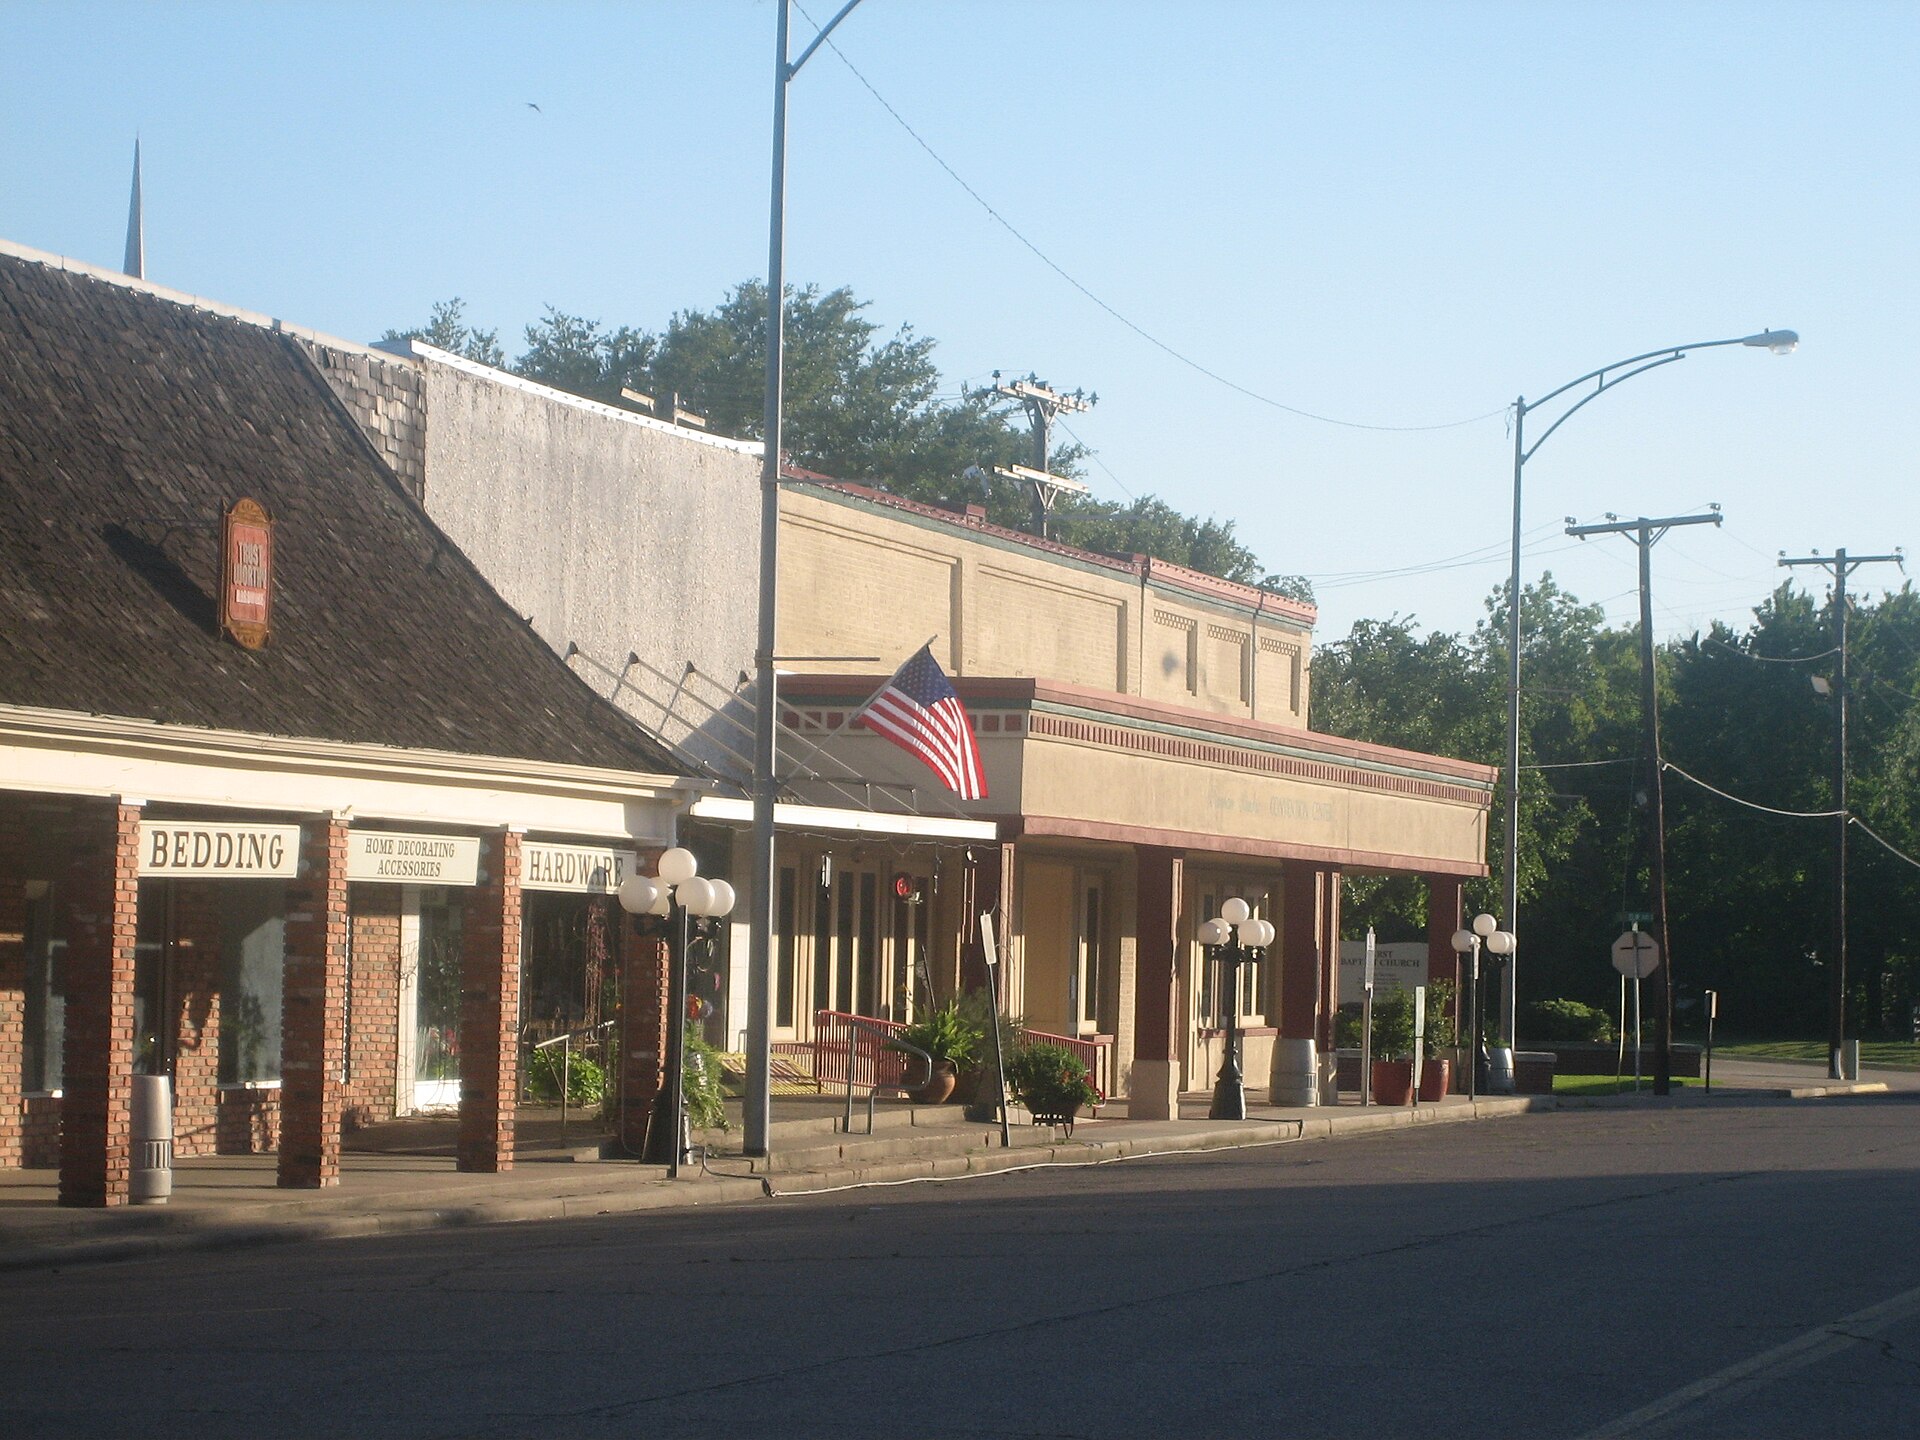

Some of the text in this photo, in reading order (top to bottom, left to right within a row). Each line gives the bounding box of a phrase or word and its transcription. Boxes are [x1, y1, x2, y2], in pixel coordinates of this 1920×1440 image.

[149, 830, 284, 870] BEDDING
[365, 838, 455, 858] HOME DECORATING
[377, 860, 441, 877] ACCESSORIES
[529, 850, 624, 888] HARDWARE
[1380, 960, 1420, 968] CHURCH
